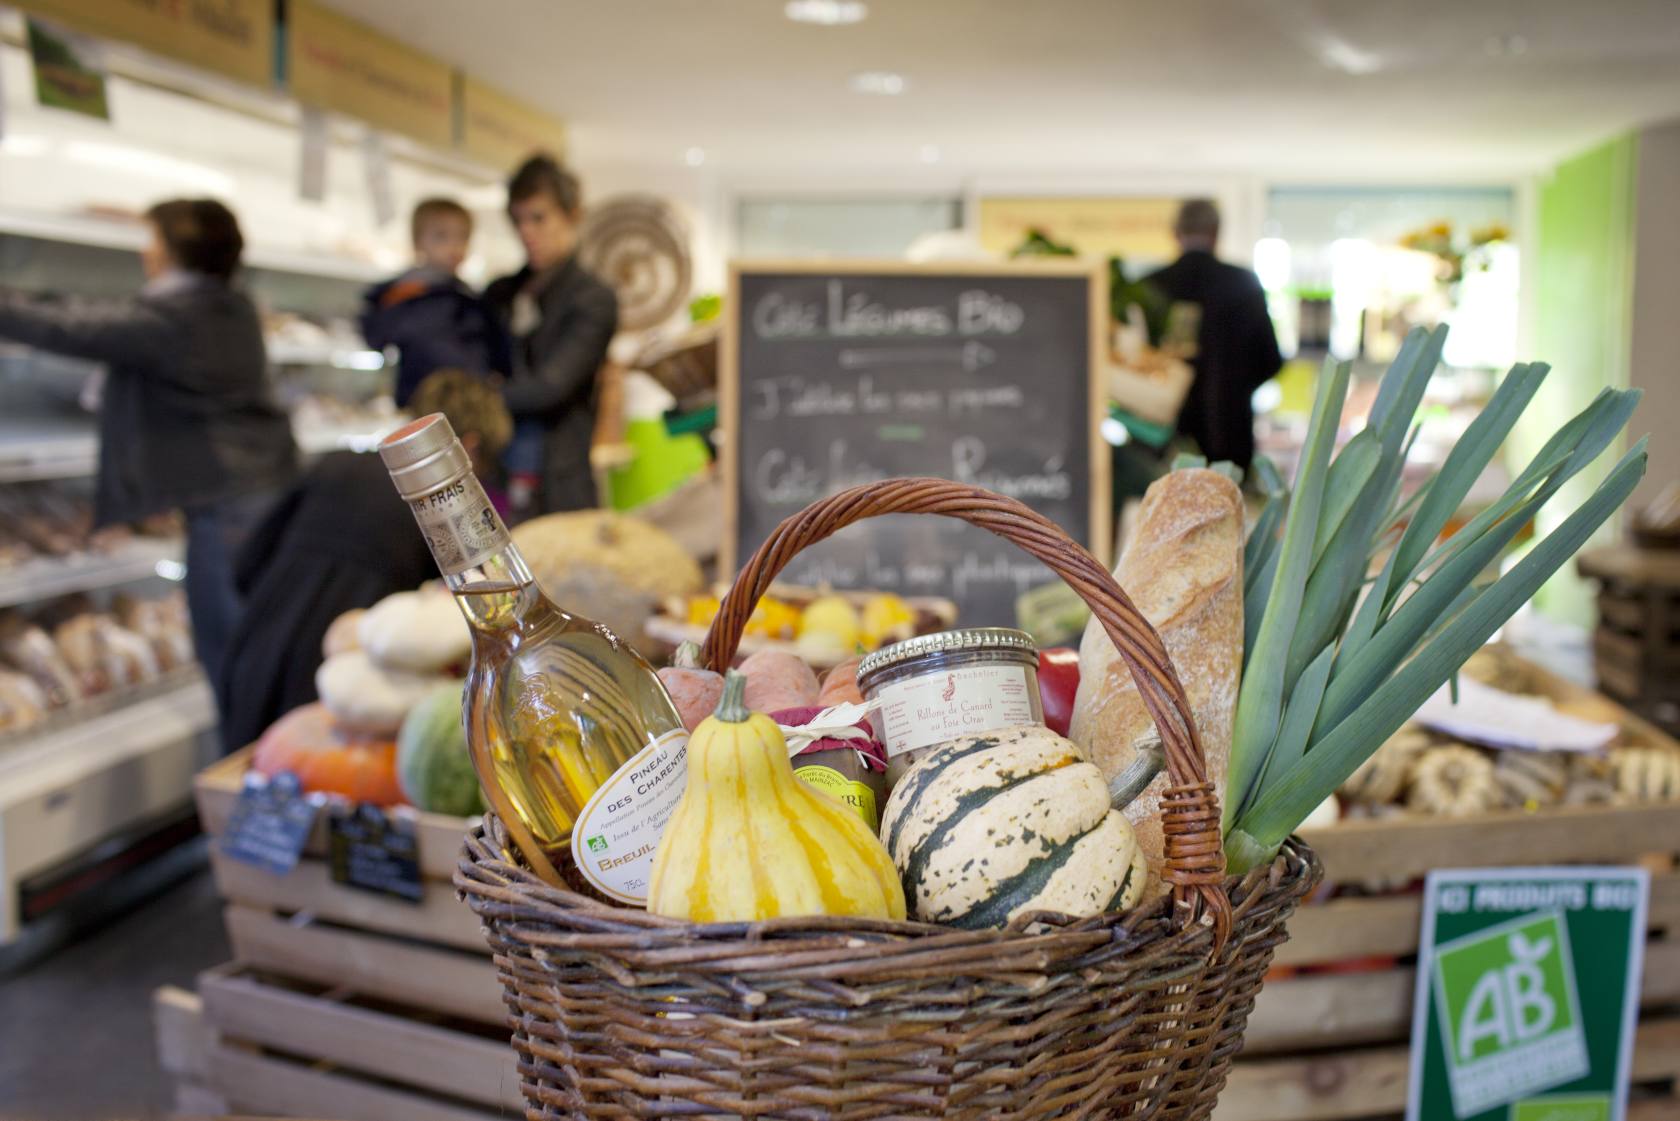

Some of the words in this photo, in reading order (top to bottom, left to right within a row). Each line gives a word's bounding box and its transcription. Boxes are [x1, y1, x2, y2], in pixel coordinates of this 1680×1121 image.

[429, 480, 465, 508] FRAIS
[607, 795, 633, 813] DES
[637, 745, 687, 795] CHARENTES
[630, 750, 668, 784] PINEAU
[841, 793, 865, 808] RE
[597, 843, 656, 872] BREUIL
[1459, 961, 1556, 1059] AB
